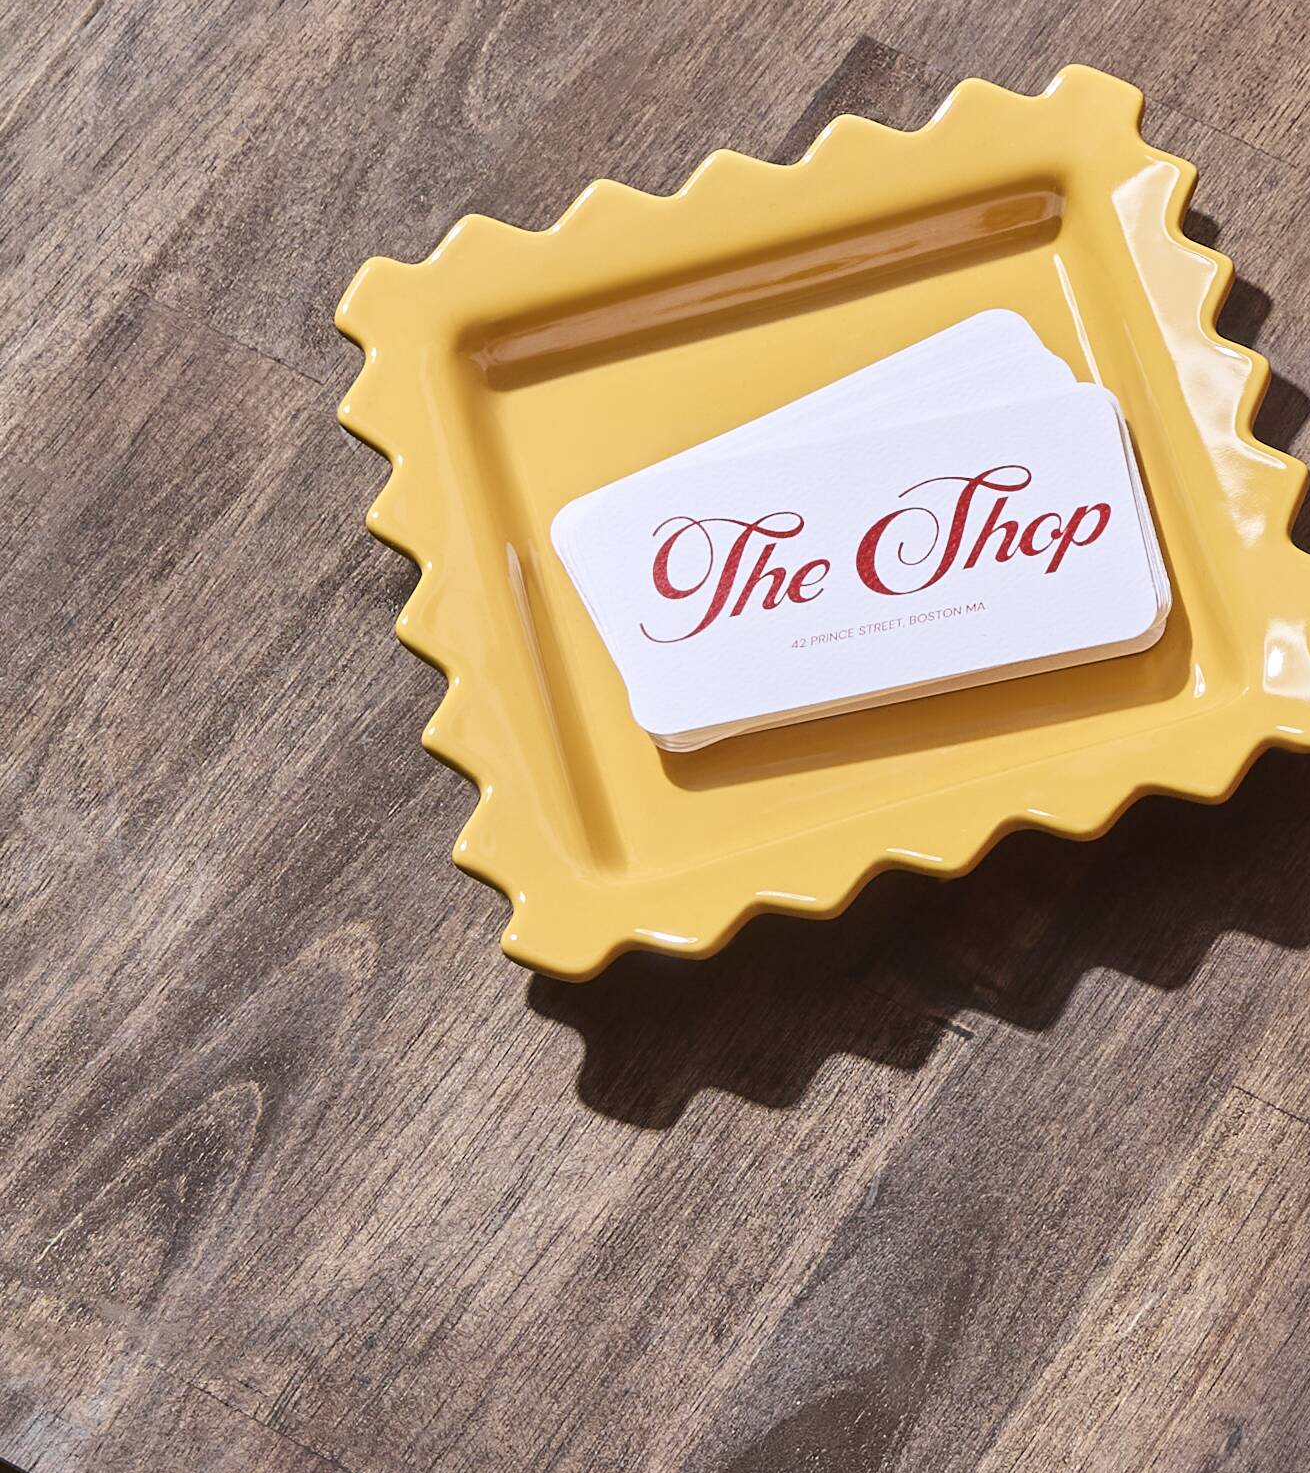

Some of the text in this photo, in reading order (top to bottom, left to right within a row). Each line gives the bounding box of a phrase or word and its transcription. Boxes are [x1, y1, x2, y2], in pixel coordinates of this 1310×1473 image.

[639, 464, 1111, 644] The Shop
[791, 601, 986, 649] 42 PRINCE STREET, BOSTON MA
